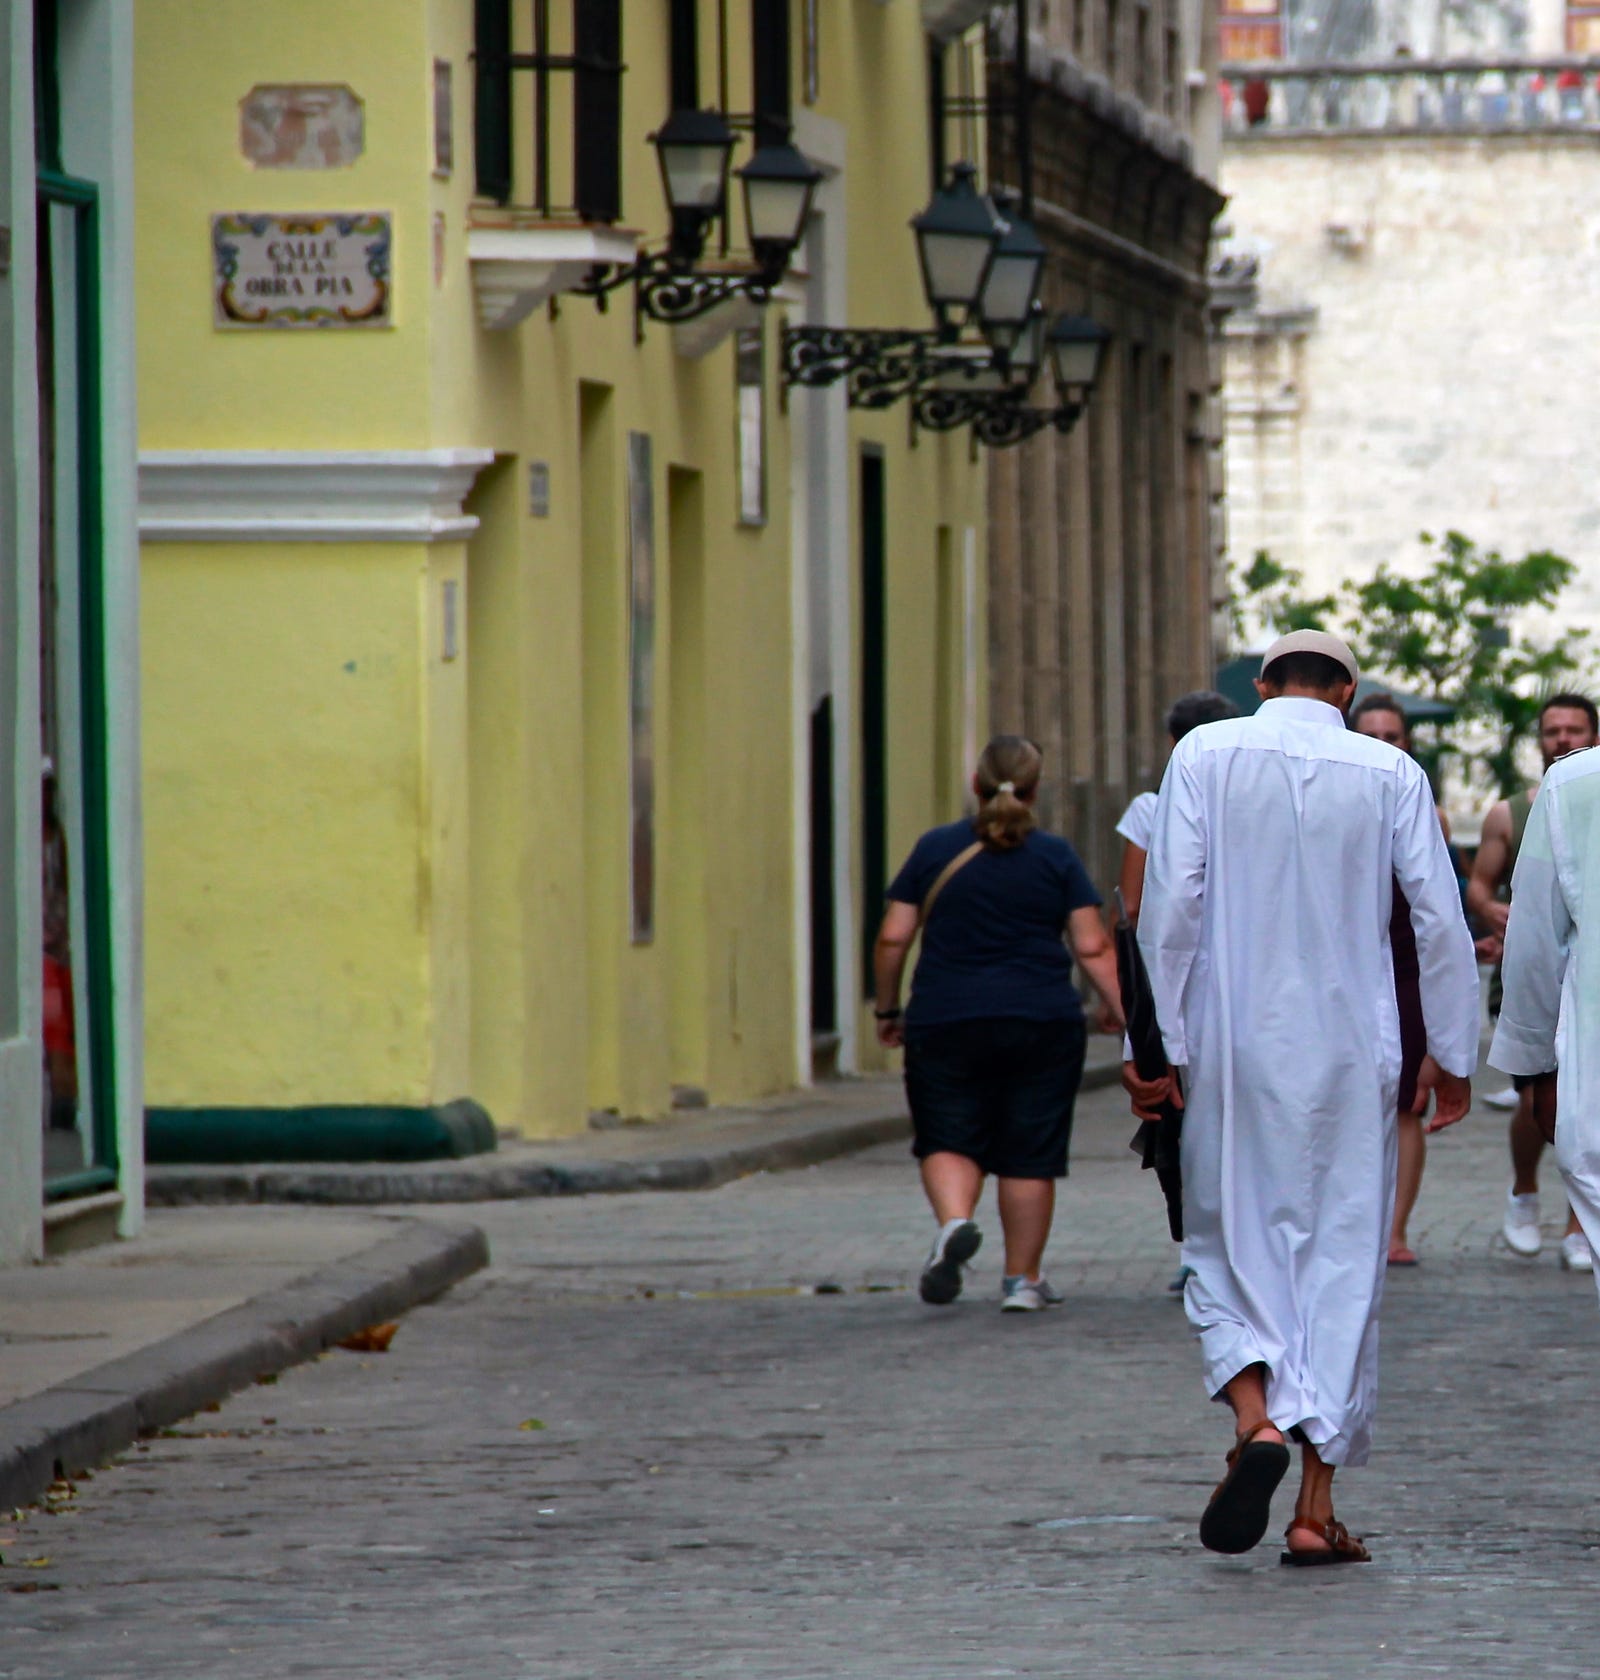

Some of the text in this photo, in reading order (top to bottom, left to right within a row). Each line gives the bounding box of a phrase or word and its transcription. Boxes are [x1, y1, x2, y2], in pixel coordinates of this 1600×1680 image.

[266, 240, 338, 261] CALLE
[245, 276, 354, 296] OBRA PIA
